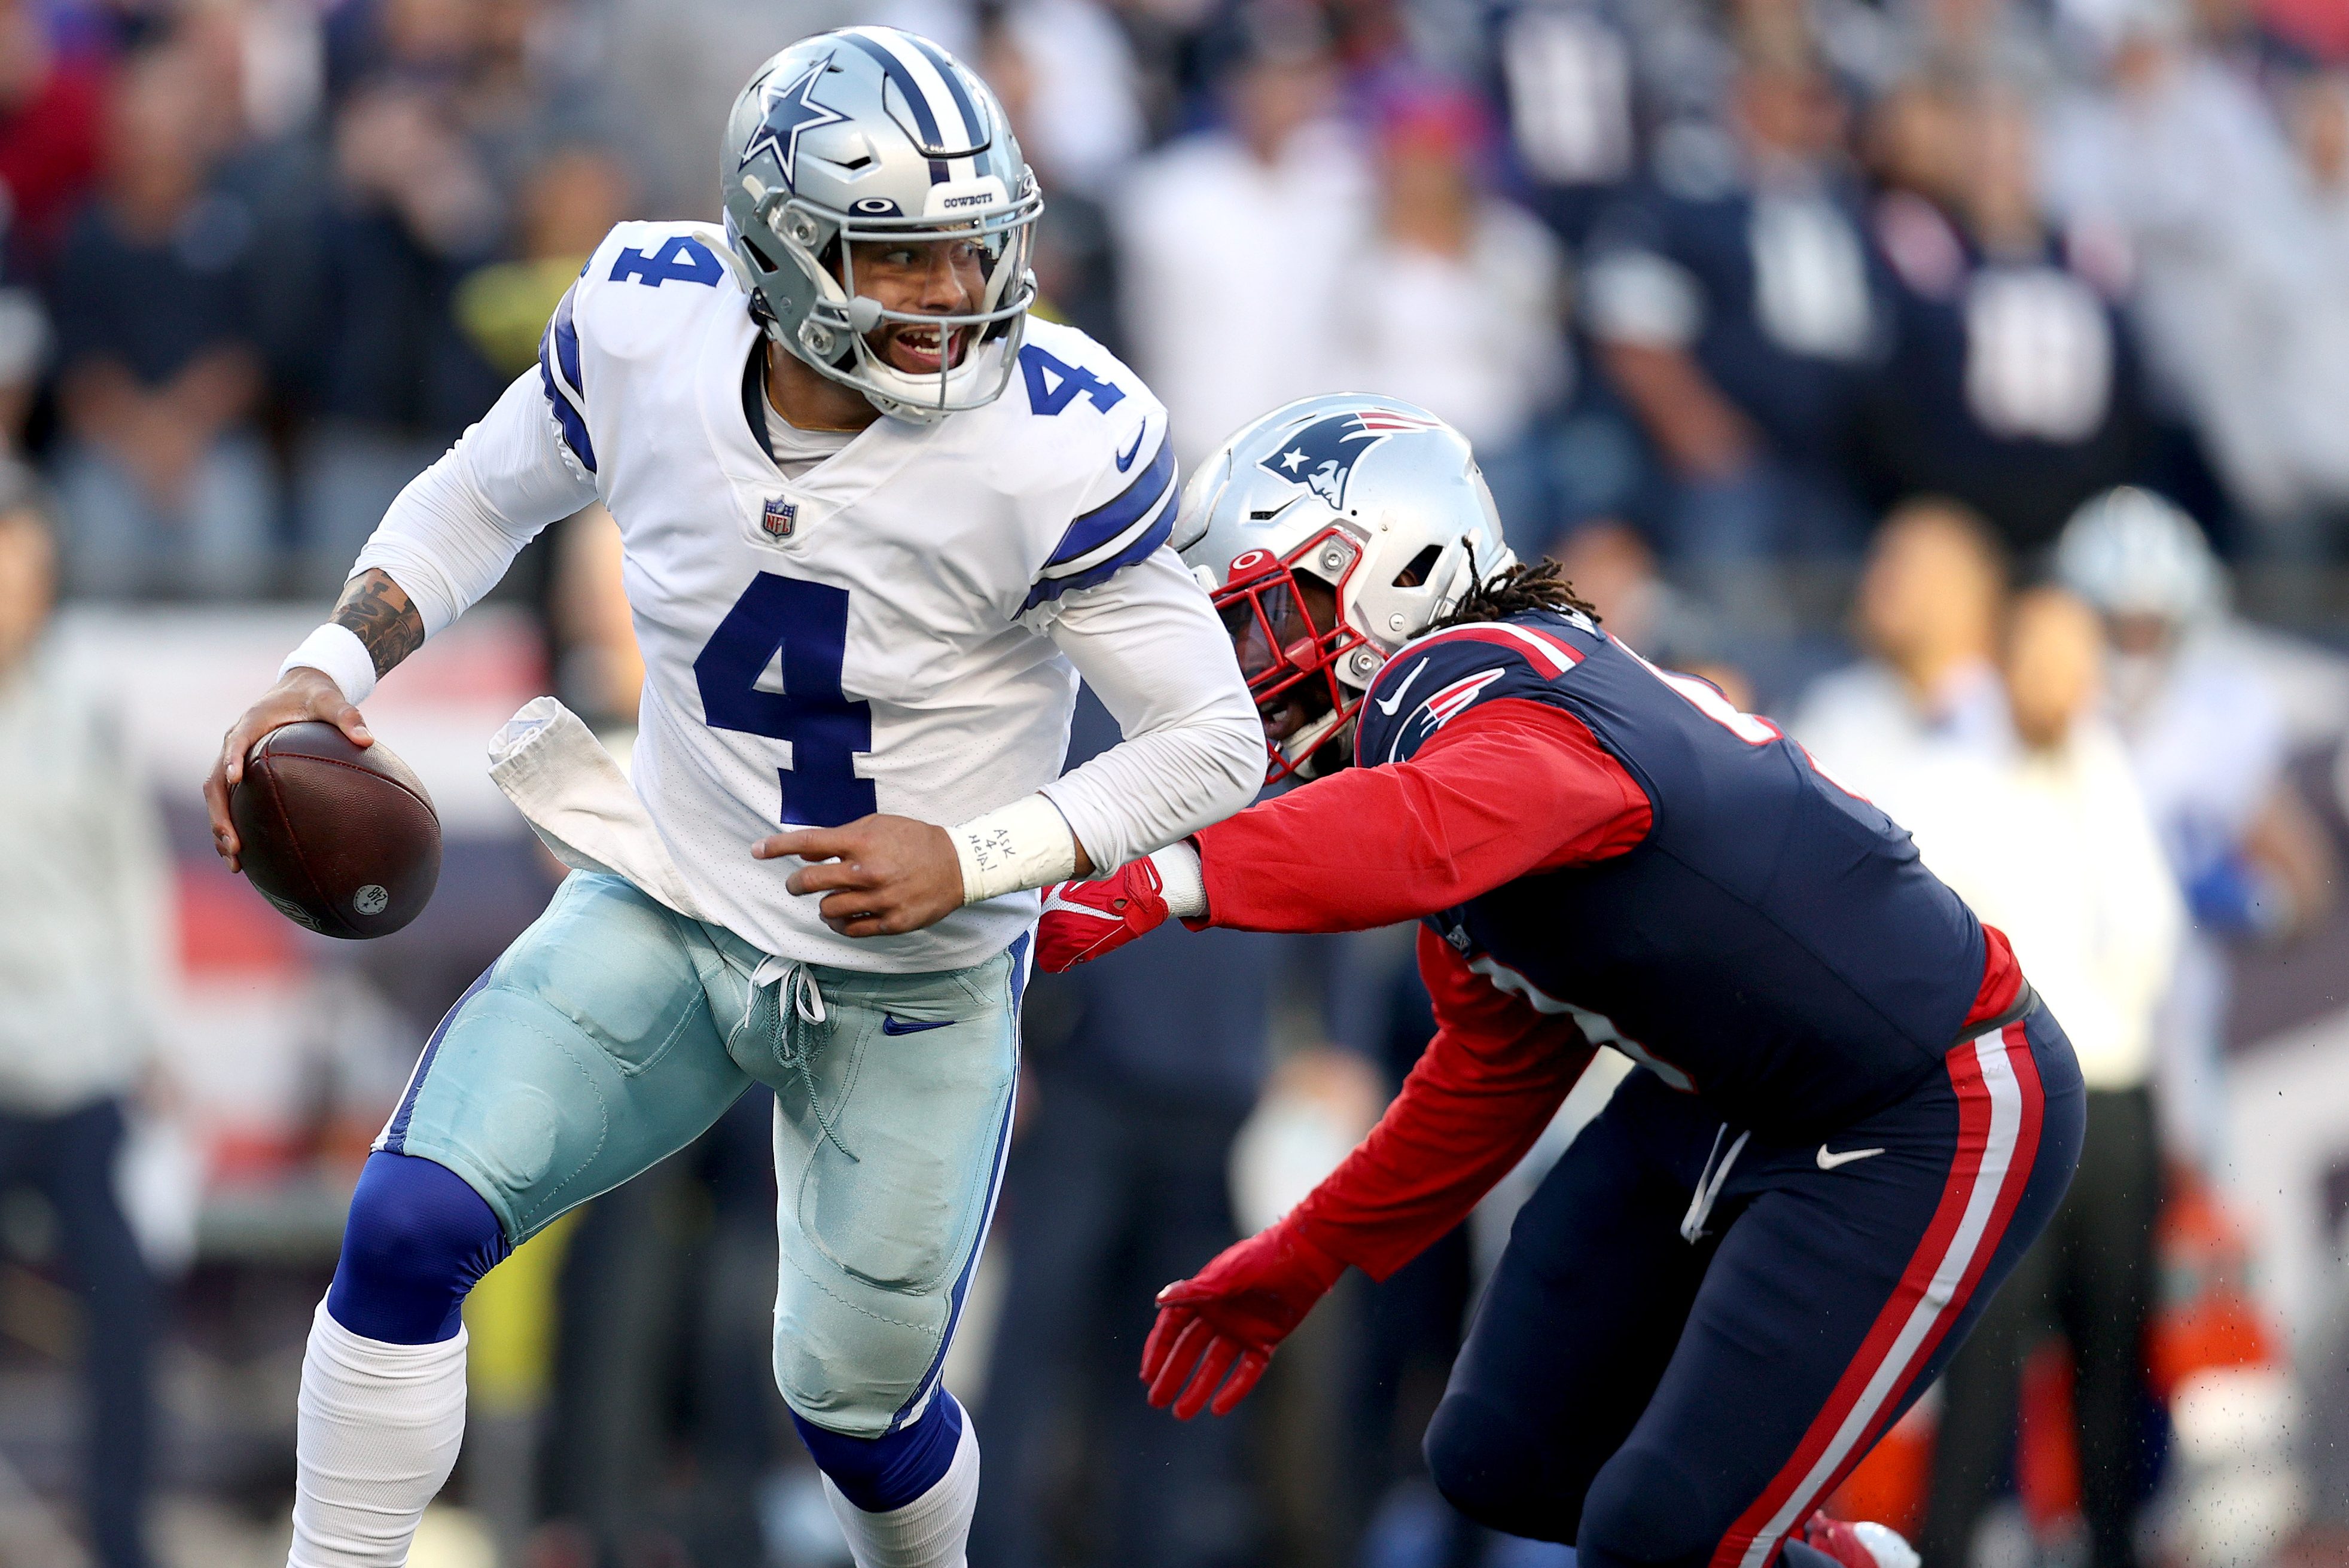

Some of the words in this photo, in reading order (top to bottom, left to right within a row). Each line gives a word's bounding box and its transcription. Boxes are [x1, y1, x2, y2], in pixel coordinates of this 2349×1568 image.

[945, 193, 992, 208] COWBOYS
[608, 236, 724, 288] 4
[1018, 343, 1126, 416] 4
[766, 514, 789, 533] NFL
[693, 570, 878, 827] 4
